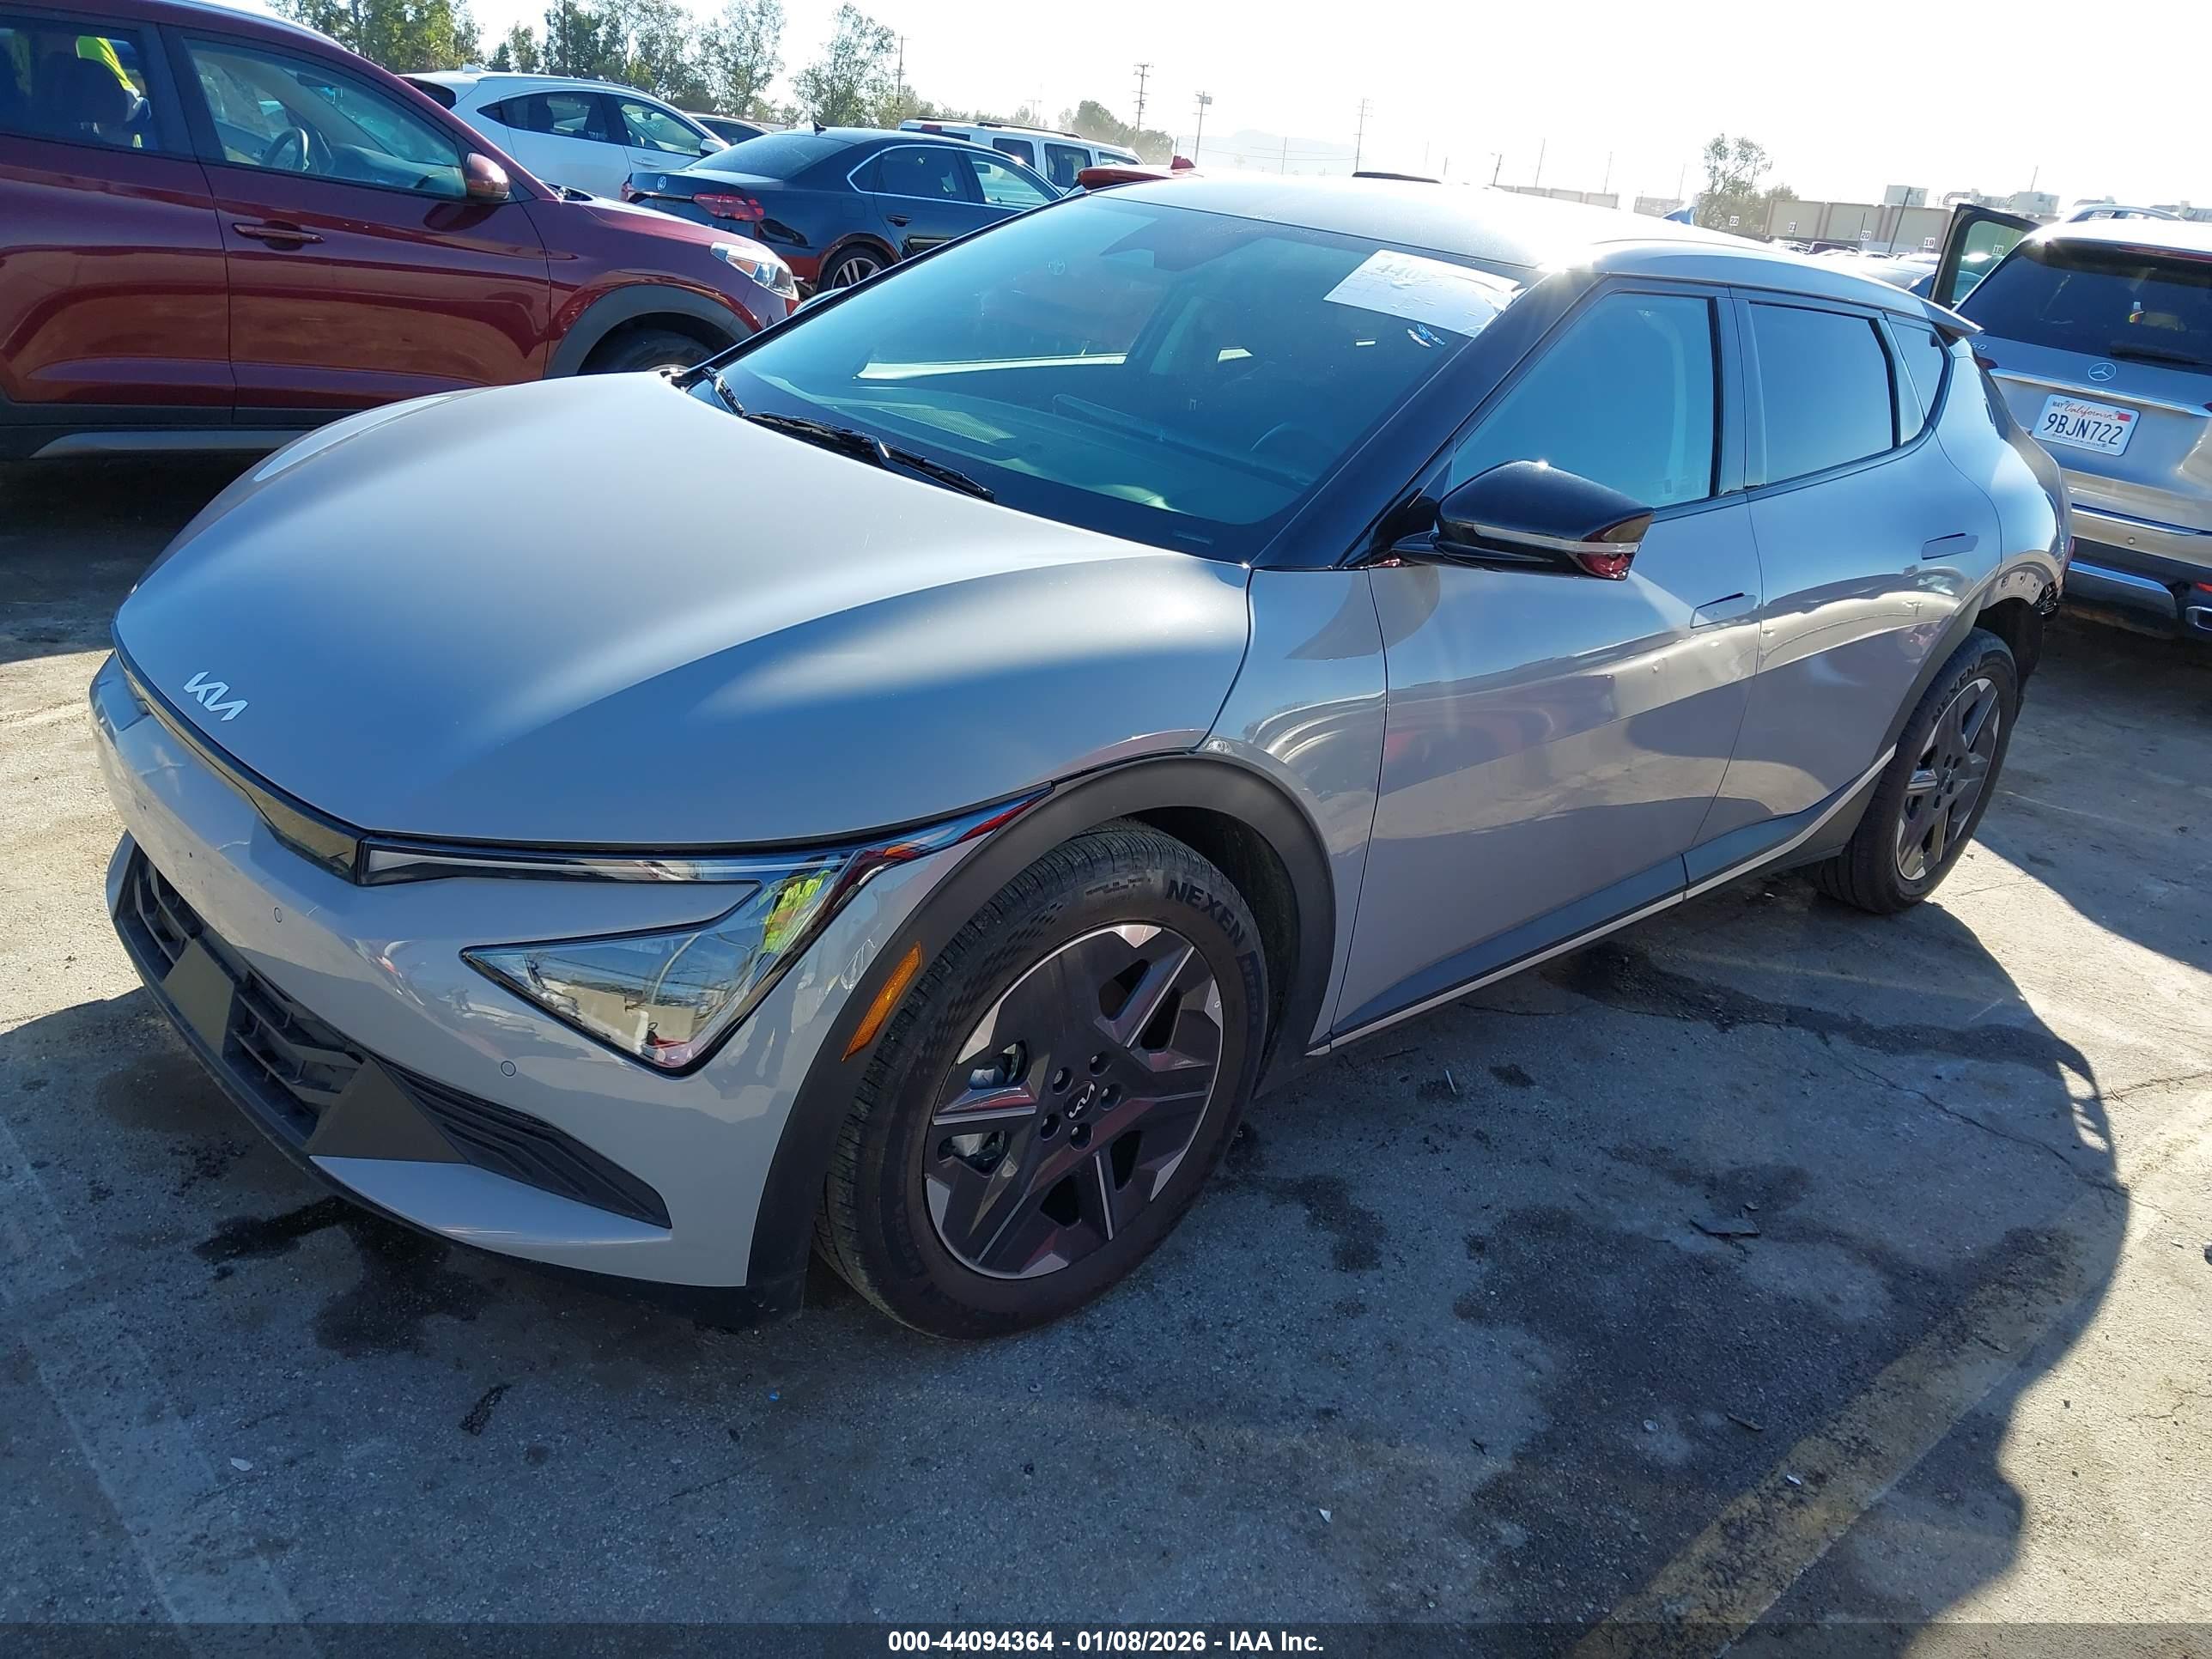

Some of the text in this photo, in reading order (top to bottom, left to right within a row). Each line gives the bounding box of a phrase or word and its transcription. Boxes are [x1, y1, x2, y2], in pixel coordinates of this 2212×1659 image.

[2042, 412, 2124, 446] 9BJN722
[2063, 403, 2118, 422] California
[183, 671, 249, 721] KIA
[1931, 663, 1975, 725] NEXEN
[1164, 878, 1246, 949] NEXEN
